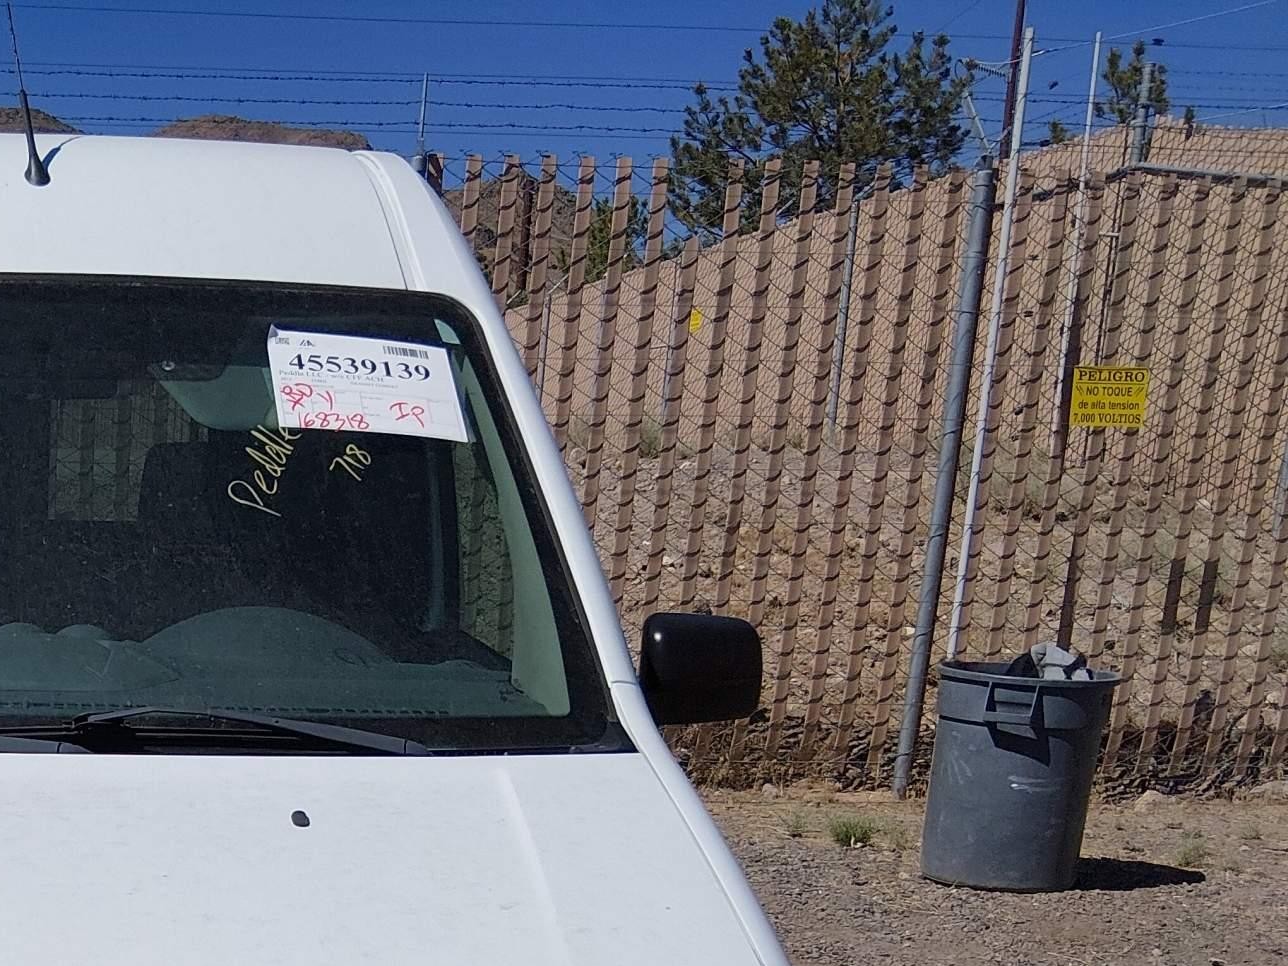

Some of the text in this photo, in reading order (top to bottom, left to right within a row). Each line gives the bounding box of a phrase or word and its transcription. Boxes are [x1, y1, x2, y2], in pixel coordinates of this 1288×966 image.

[289, 353, 431, 381] 45539139
[1078, 369, 1145, 382] PELIGRO
[1086, 386, 1133, 397] NO TOQUE
[1078, 400, 1140, 410] de alta tension
[1097, 413, 1141, 424] VOLTIOS
